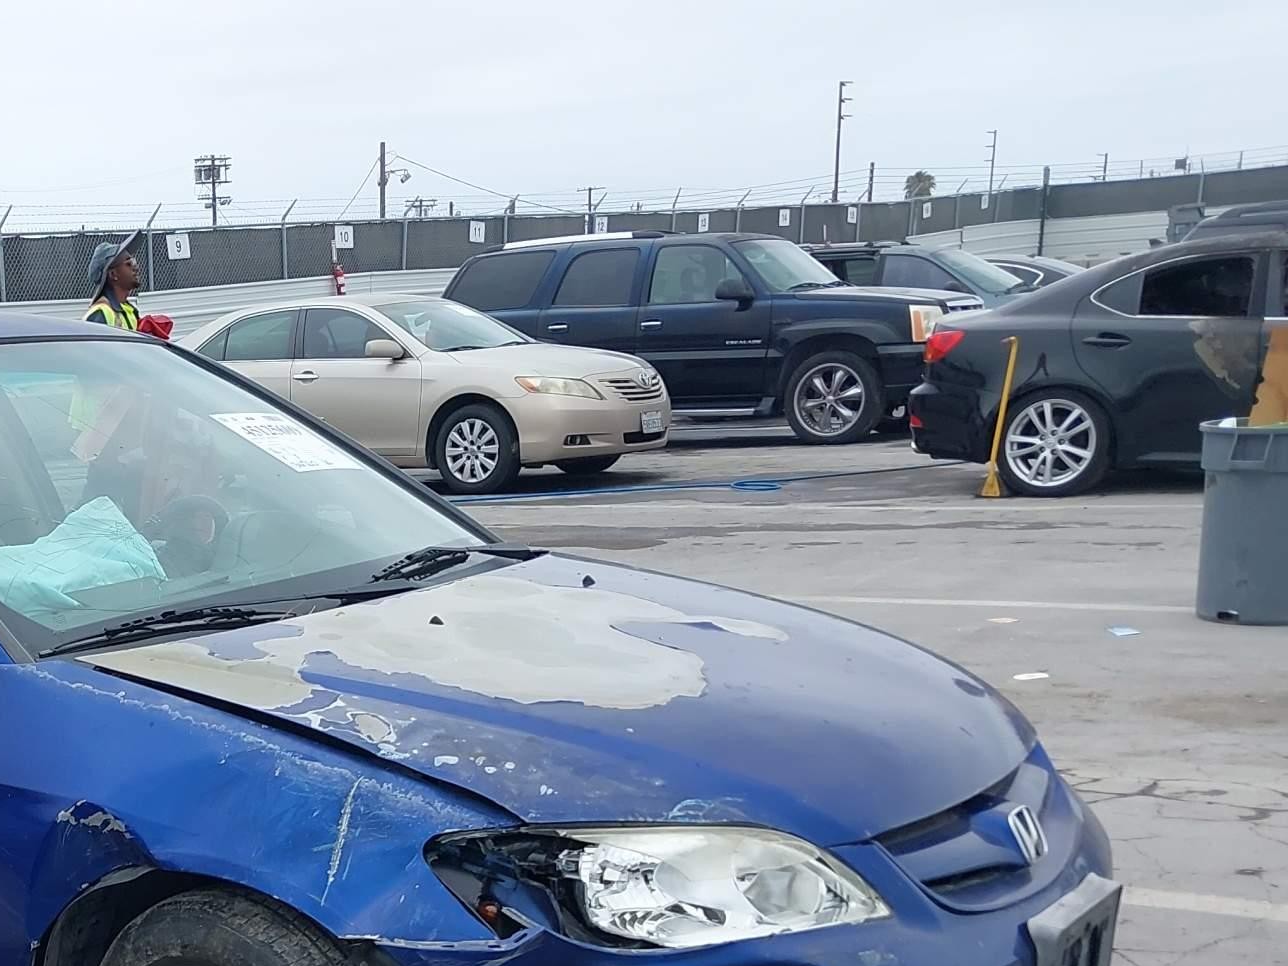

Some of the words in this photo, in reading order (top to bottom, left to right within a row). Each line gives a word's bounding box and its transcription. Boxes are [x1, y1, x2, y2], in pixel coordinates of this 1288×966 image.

[473, 227, 481, 238] 11
[597, 222, 604, 232] 12
[339, 231, 349, 243] 10
[175, 240, 182, 253] 9
